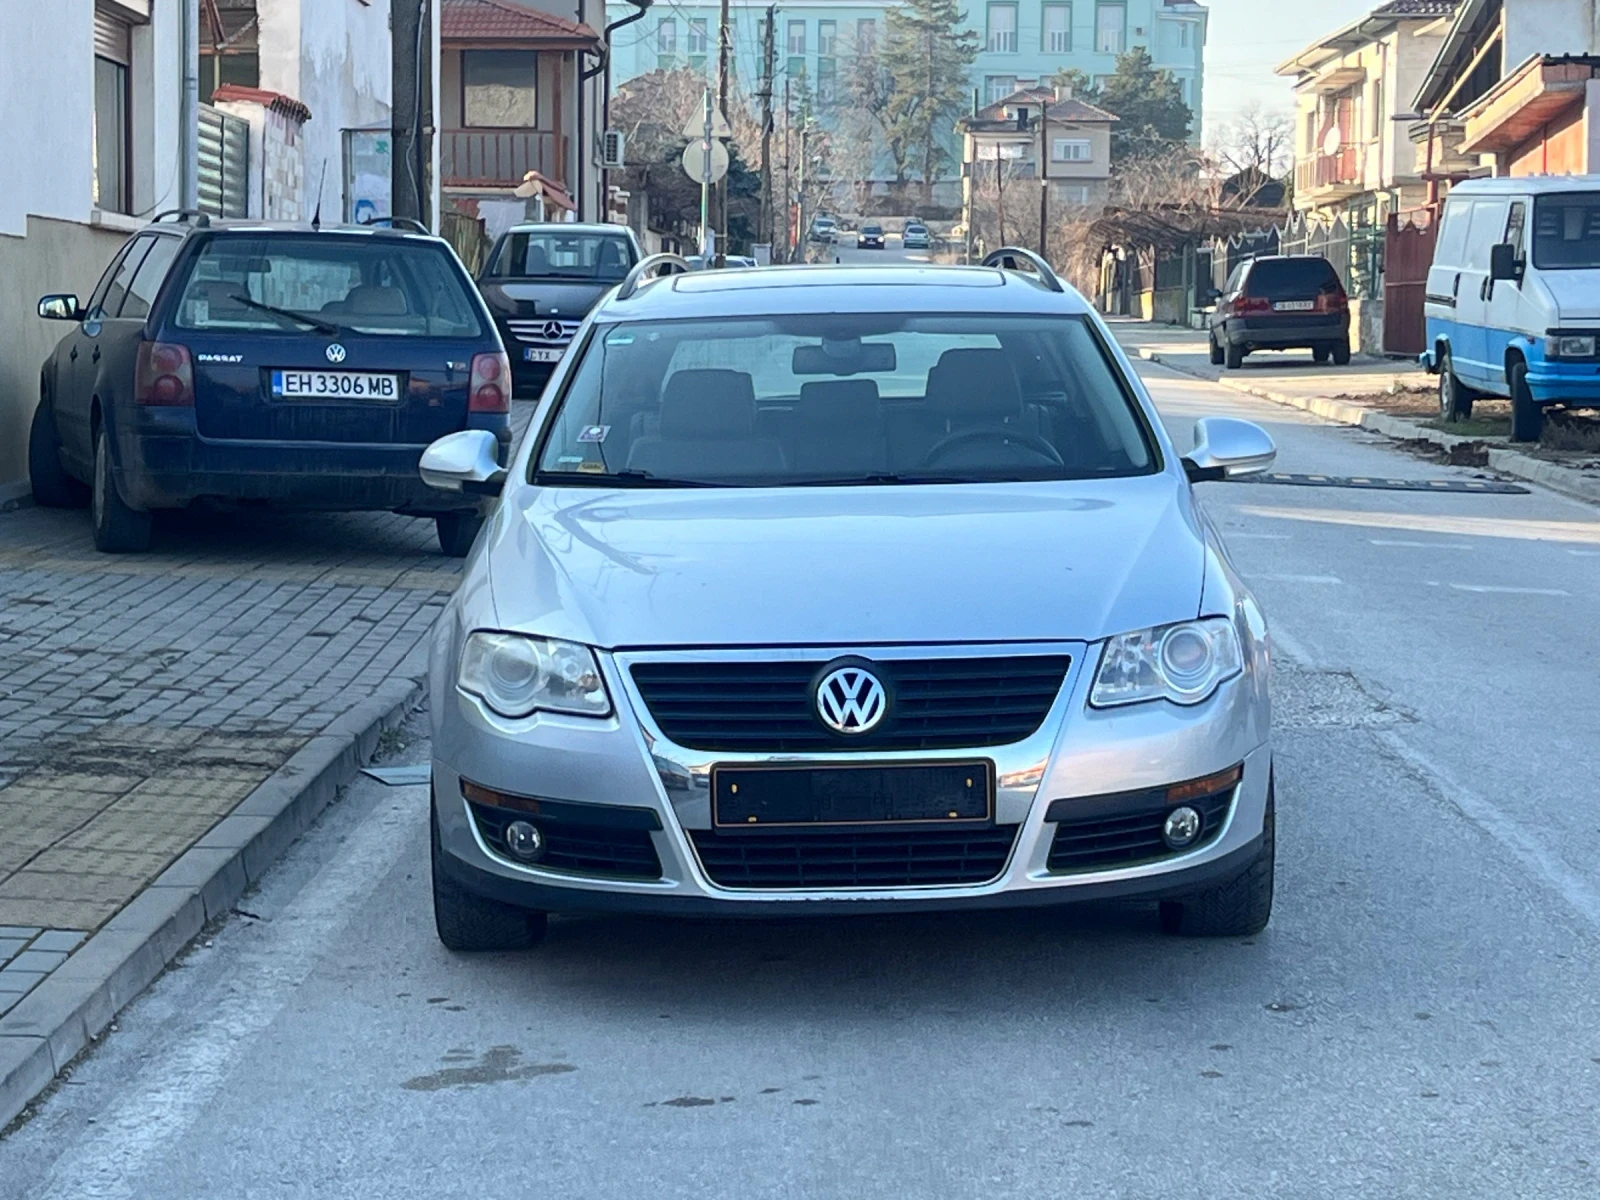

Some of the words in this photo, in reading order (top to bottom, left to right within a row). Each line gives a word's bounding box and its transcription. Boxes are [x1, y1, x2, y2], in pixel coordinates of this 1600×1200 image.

[285, 374, 312, 393] EH
[316, 375, 364, 395] 3306
[368, 377, 393, 396] MB
[818, 668, 885, 733] VW
